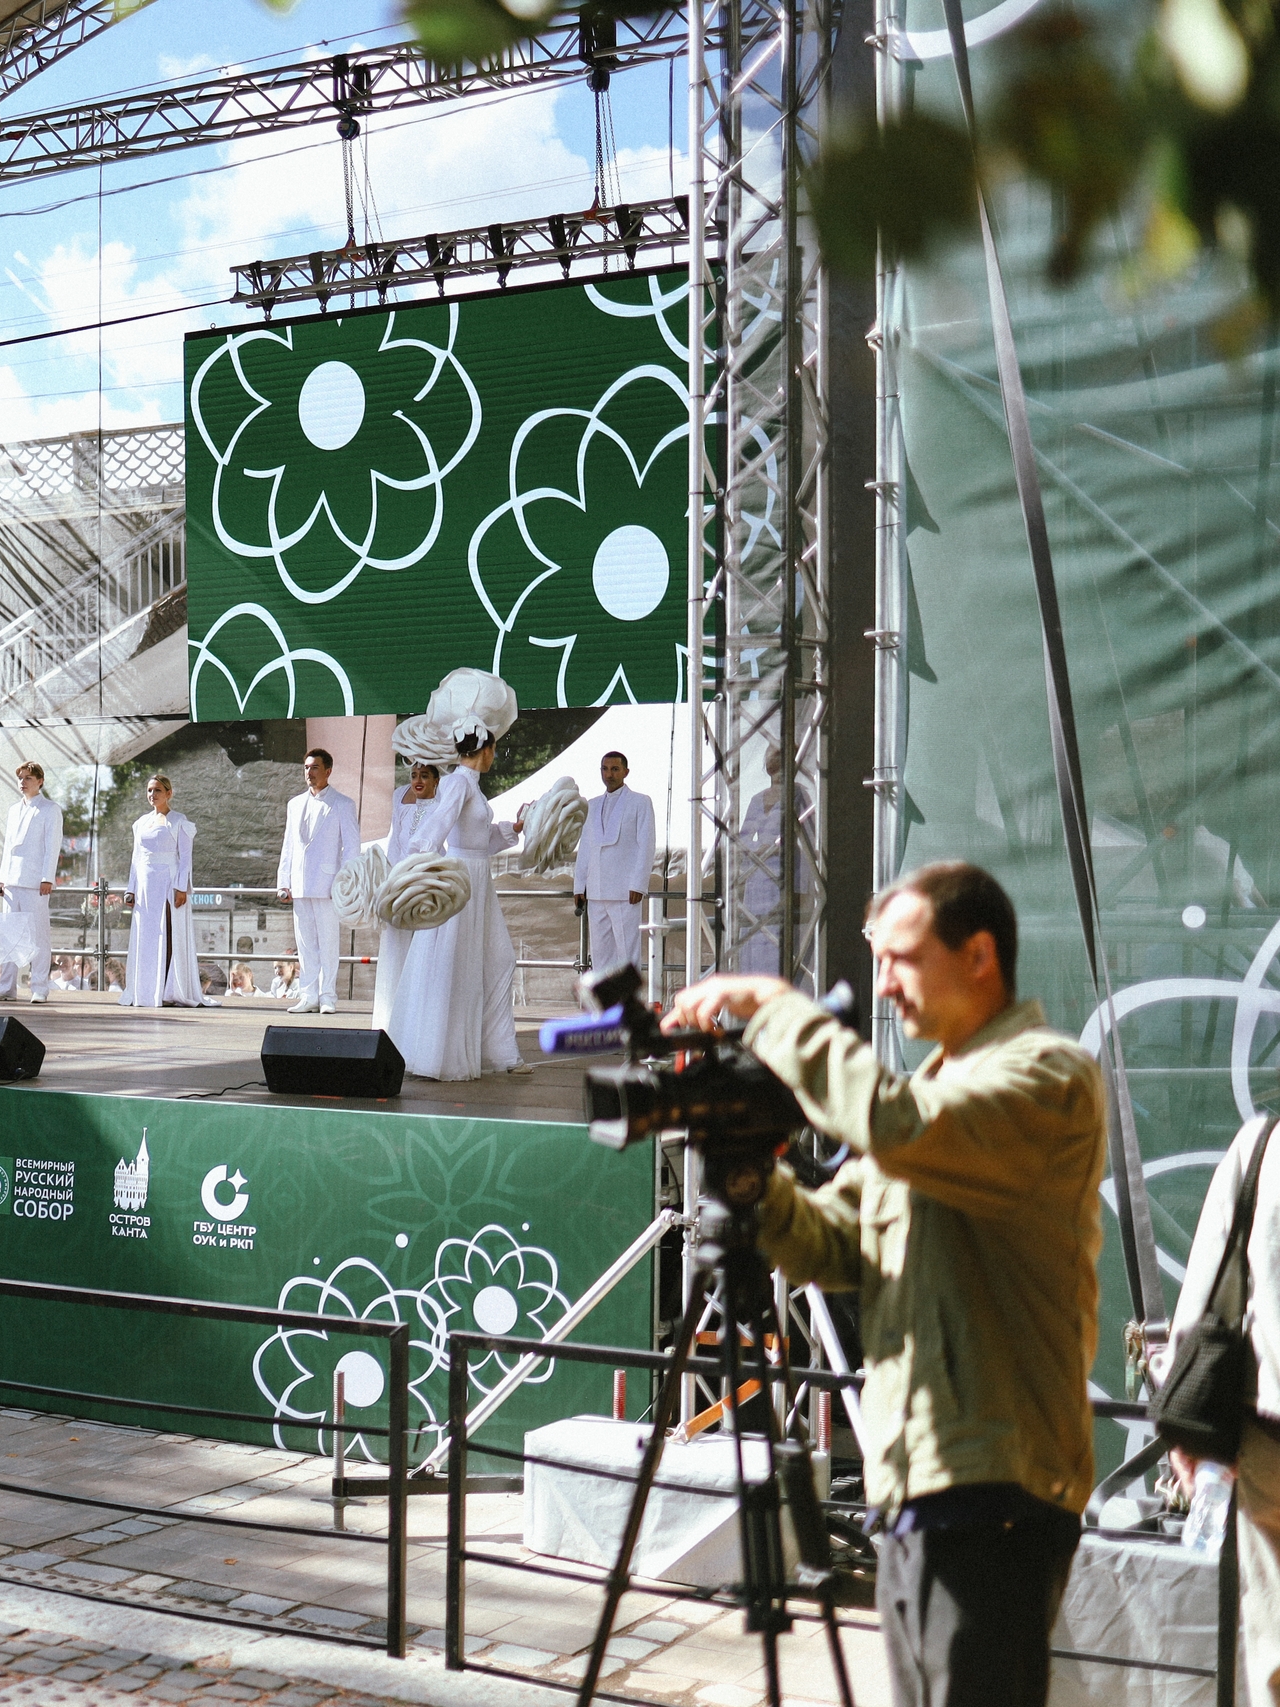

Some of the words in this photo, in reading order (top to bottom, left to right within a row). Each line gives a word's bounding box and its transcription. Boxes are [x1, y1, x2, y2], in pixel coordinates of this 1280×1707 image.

[15, 1158, 75, 1172] ВСЕМИРНЫЙ
[15, 1170, 74, 1187] РУССКИЙ
[14, 1186, 73, 1201] НАРОДНЫЙ
[13, 1199, 74, 1221] СОБОР
[109, 1213, 151, 1227] ОСТРОВ
[111, 1225, 148, 1239] КАНТА
[193, 1221, 215, 1233] ГБУ
[217, 1223, 256, 1237] ЦЕНТР
[192, 1234, 217, 1247] ОУК
[229, 1238, 254, 1250] РКП
